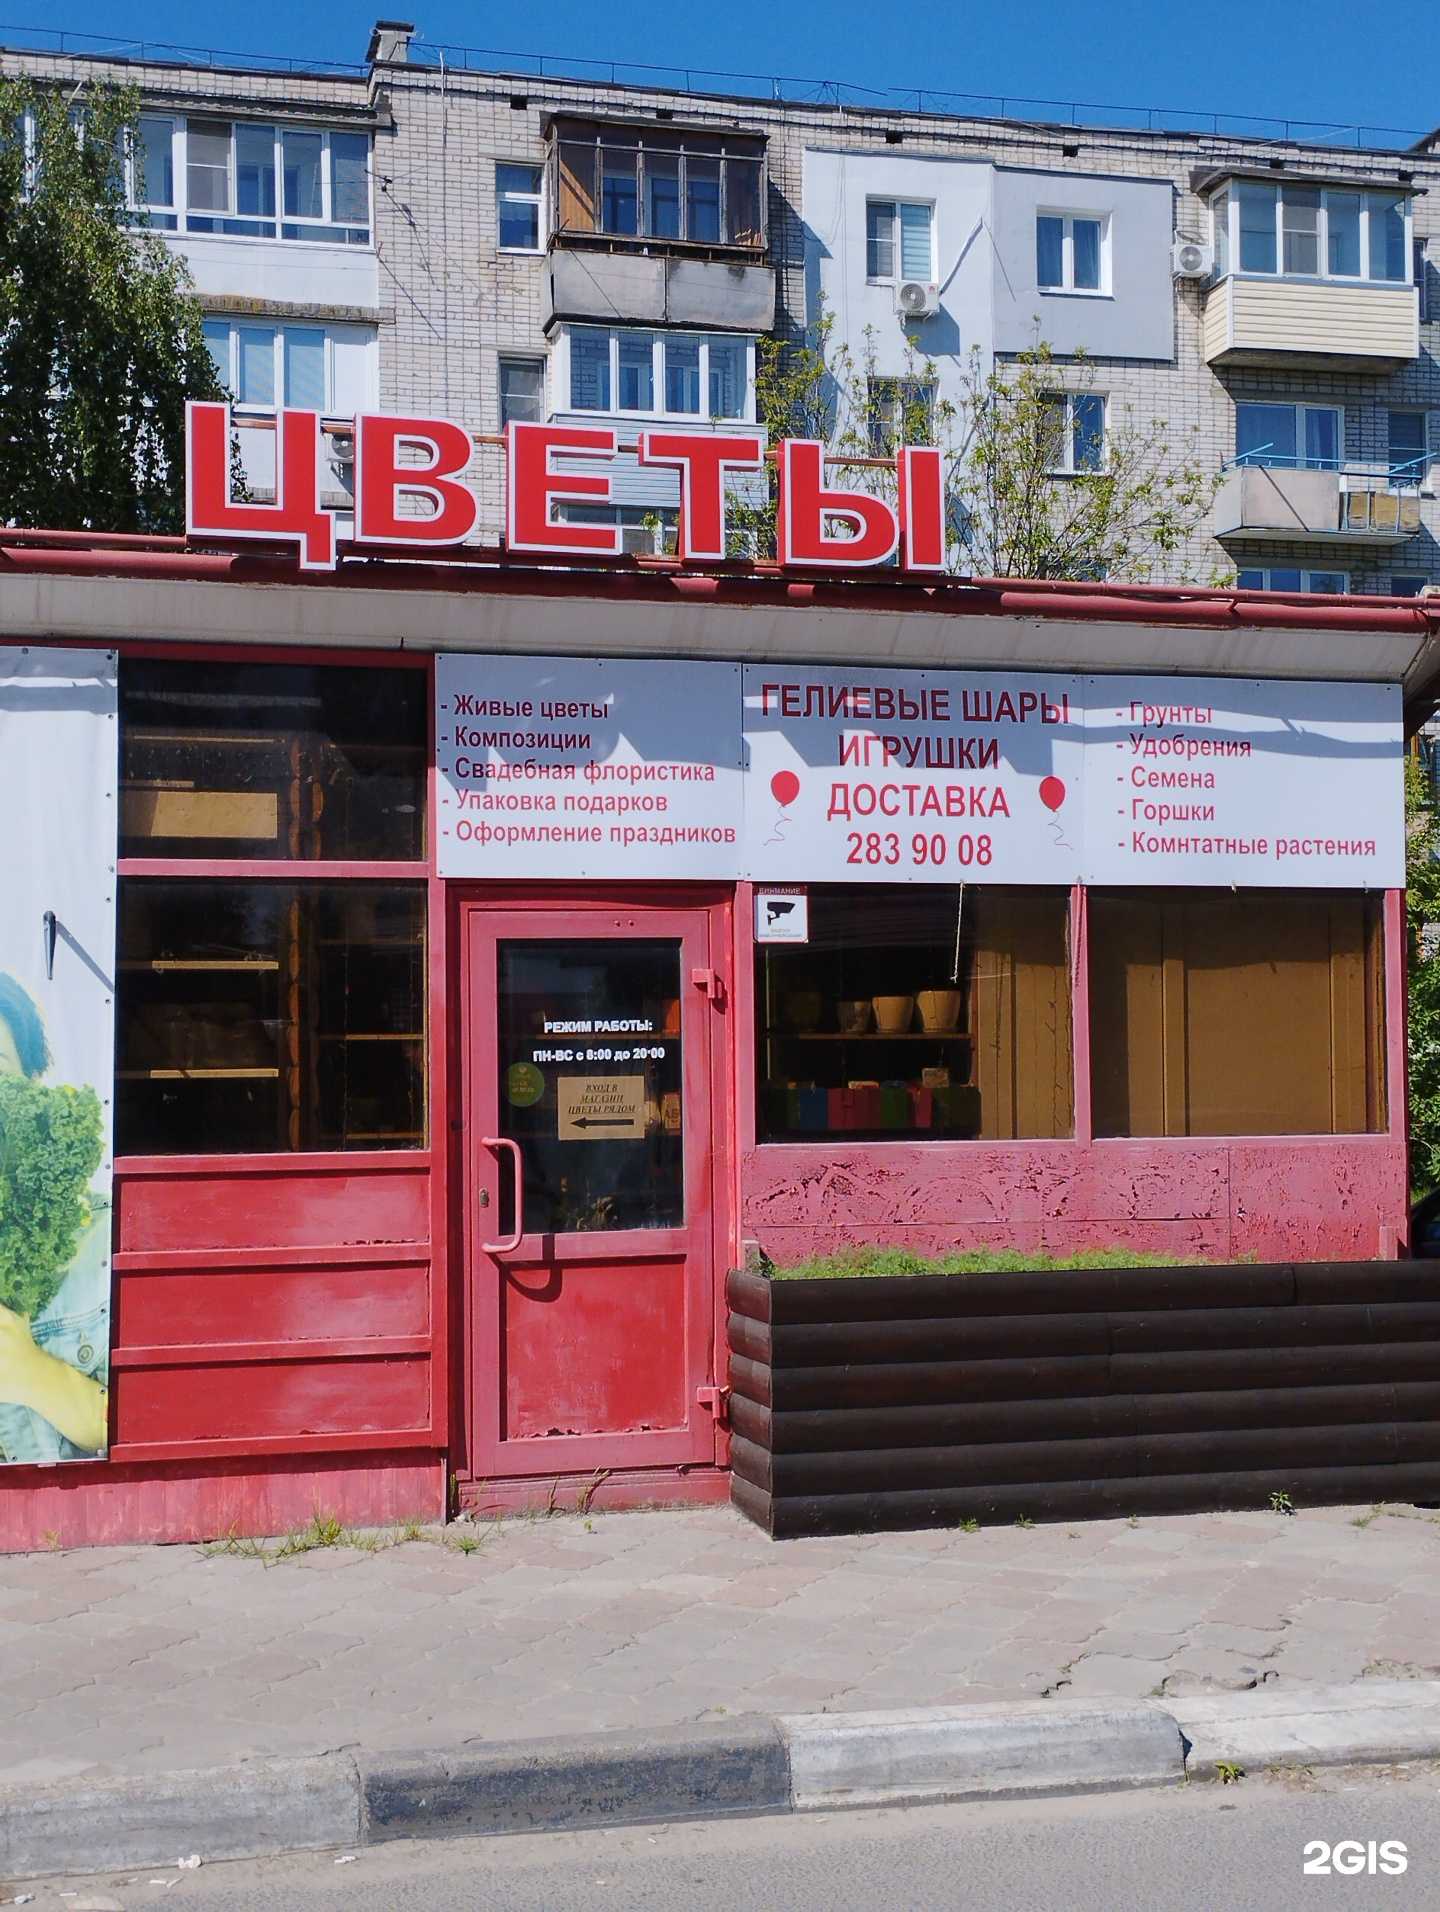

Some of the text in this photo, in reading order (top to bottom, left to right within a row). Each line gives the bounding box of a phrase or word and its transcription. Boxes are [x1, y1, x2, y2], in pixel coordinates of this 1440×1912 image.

[185, 401, 945, 573] ЦВЕТЫ
[454, 694, 533, 717] Живые
[541, 701, 608, 720] цветы
[762, 684, 1069, 724] ГЕЛИЕВЫЕ ШАРЫ
[1130, 701, 1212, 727] Грунты
[455, 726, 591, 752] Композиции
[838, 734, 999, 769] ИГРУШКИ
[1130, 733, 1252, 760] Удобрения
[455, 757, 575, 780] Свадебная
[584, 760, 715, 784] флористика
[1131, 766, 1215, 789] Семена
[456, 789, 556, 811] Упаковка
[563, 796, 668, 815] подарков
[826, 783, 1011, 821] ДОСТАВКА
[1132, 799, 1215, 825] Горшки
[456, 820, 602, 846] Оформление
[610, 829, 736, 846] праздников
[1132, 831, 1268, 855] Комнтатные
[1276, 838, 1376, 860] растения
[846, 832, 992, 866] 283 90 08
[544, 1019, 653, 1033] РЕЖИМ РАБОТЫ:
[533, 1050, 573, 1062] ПН-ВС
[586, 1049, 611, 1060] 8:00
[614, 1049, 630, 1061] до
[585, 1084, 611, 1093] ВХОД
[568, 1105, 635, 1115] ЦВЕТЫ РЯДОМ
